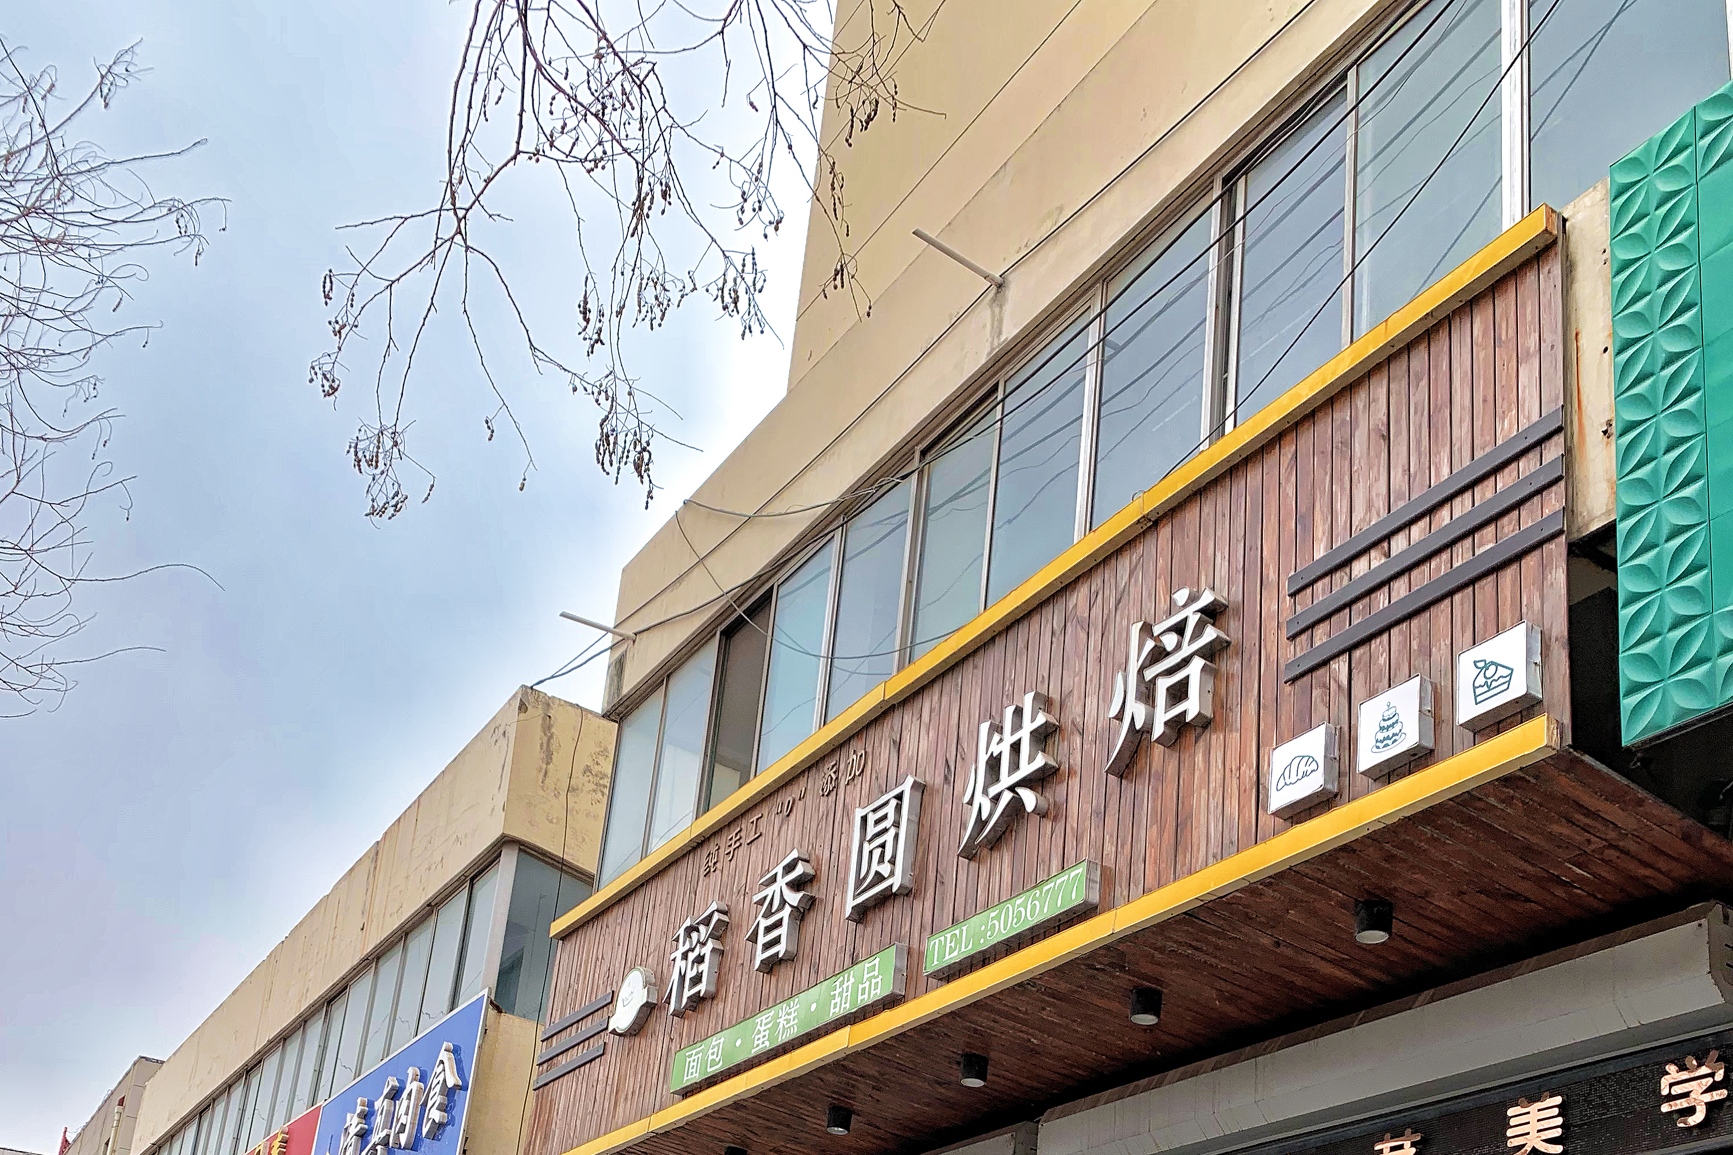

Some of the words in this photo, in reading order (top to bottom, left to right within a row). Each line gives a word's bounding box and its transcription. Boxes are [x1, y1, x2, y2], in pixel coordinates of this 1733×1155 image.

[664, 586, 1230, 1016] 稻香圆烘焙
